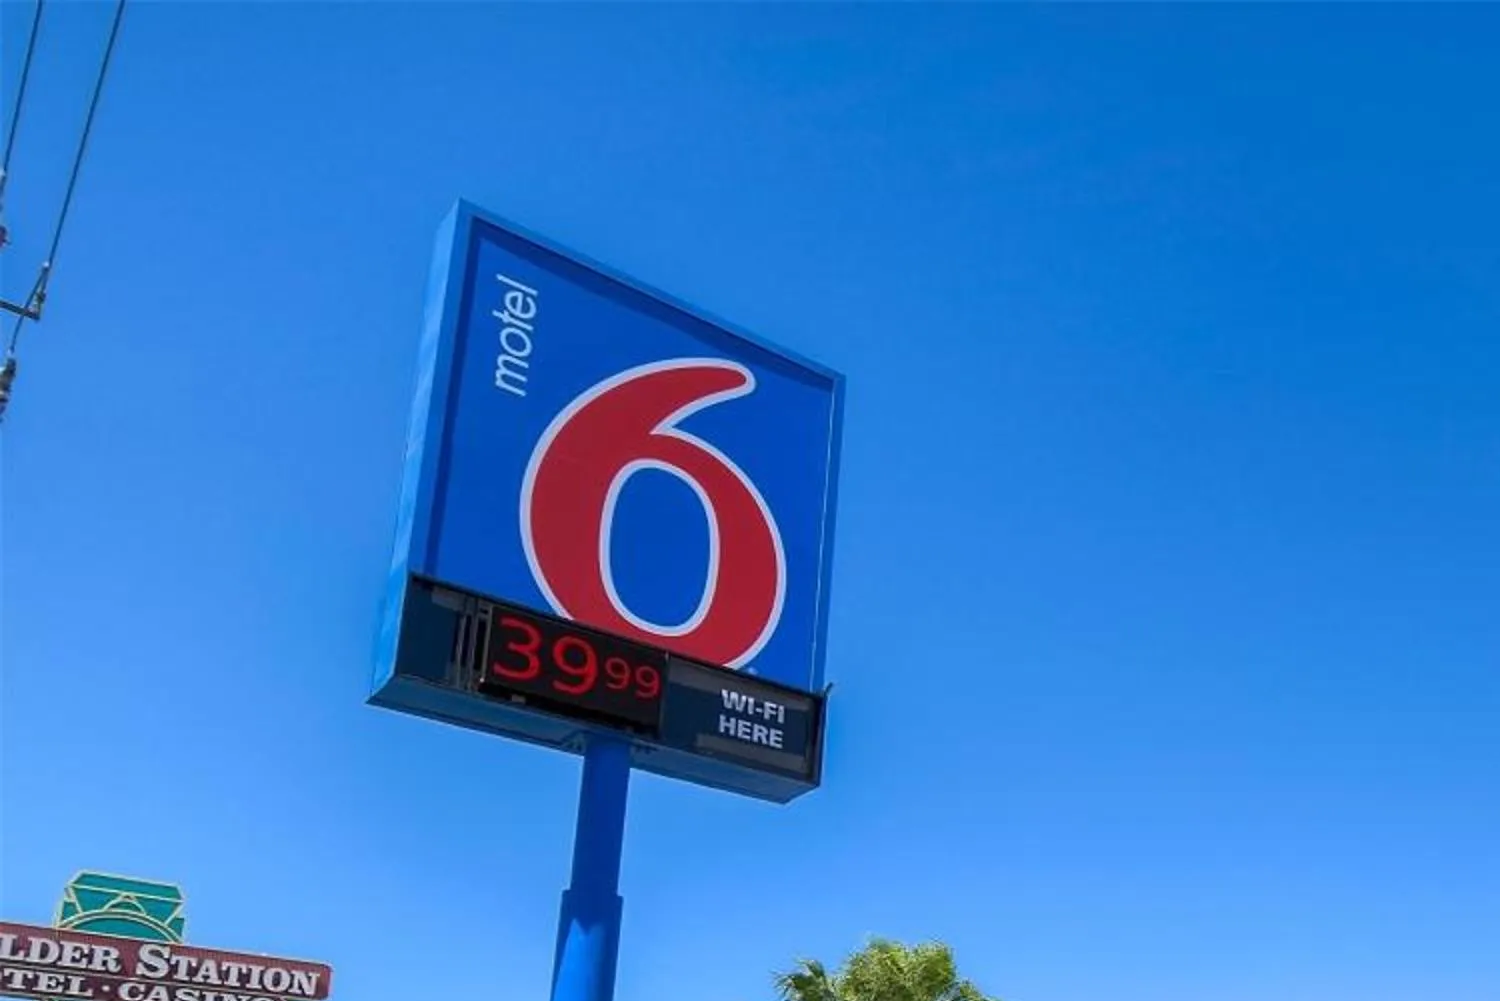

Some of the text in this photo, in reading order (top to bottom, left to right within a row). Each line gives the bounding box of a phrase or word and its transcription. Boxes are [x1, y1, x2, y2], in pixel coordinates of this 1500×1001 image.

[494, 274, 538, 397] motel
[519, 357, 787, 671] 6
[720, 688, 786, 725] WI-FI
[717, 714, 785, 751] HERE
[0, 932, 321, 998] LDER STATION
[0, 967, 94, 997] TEL
